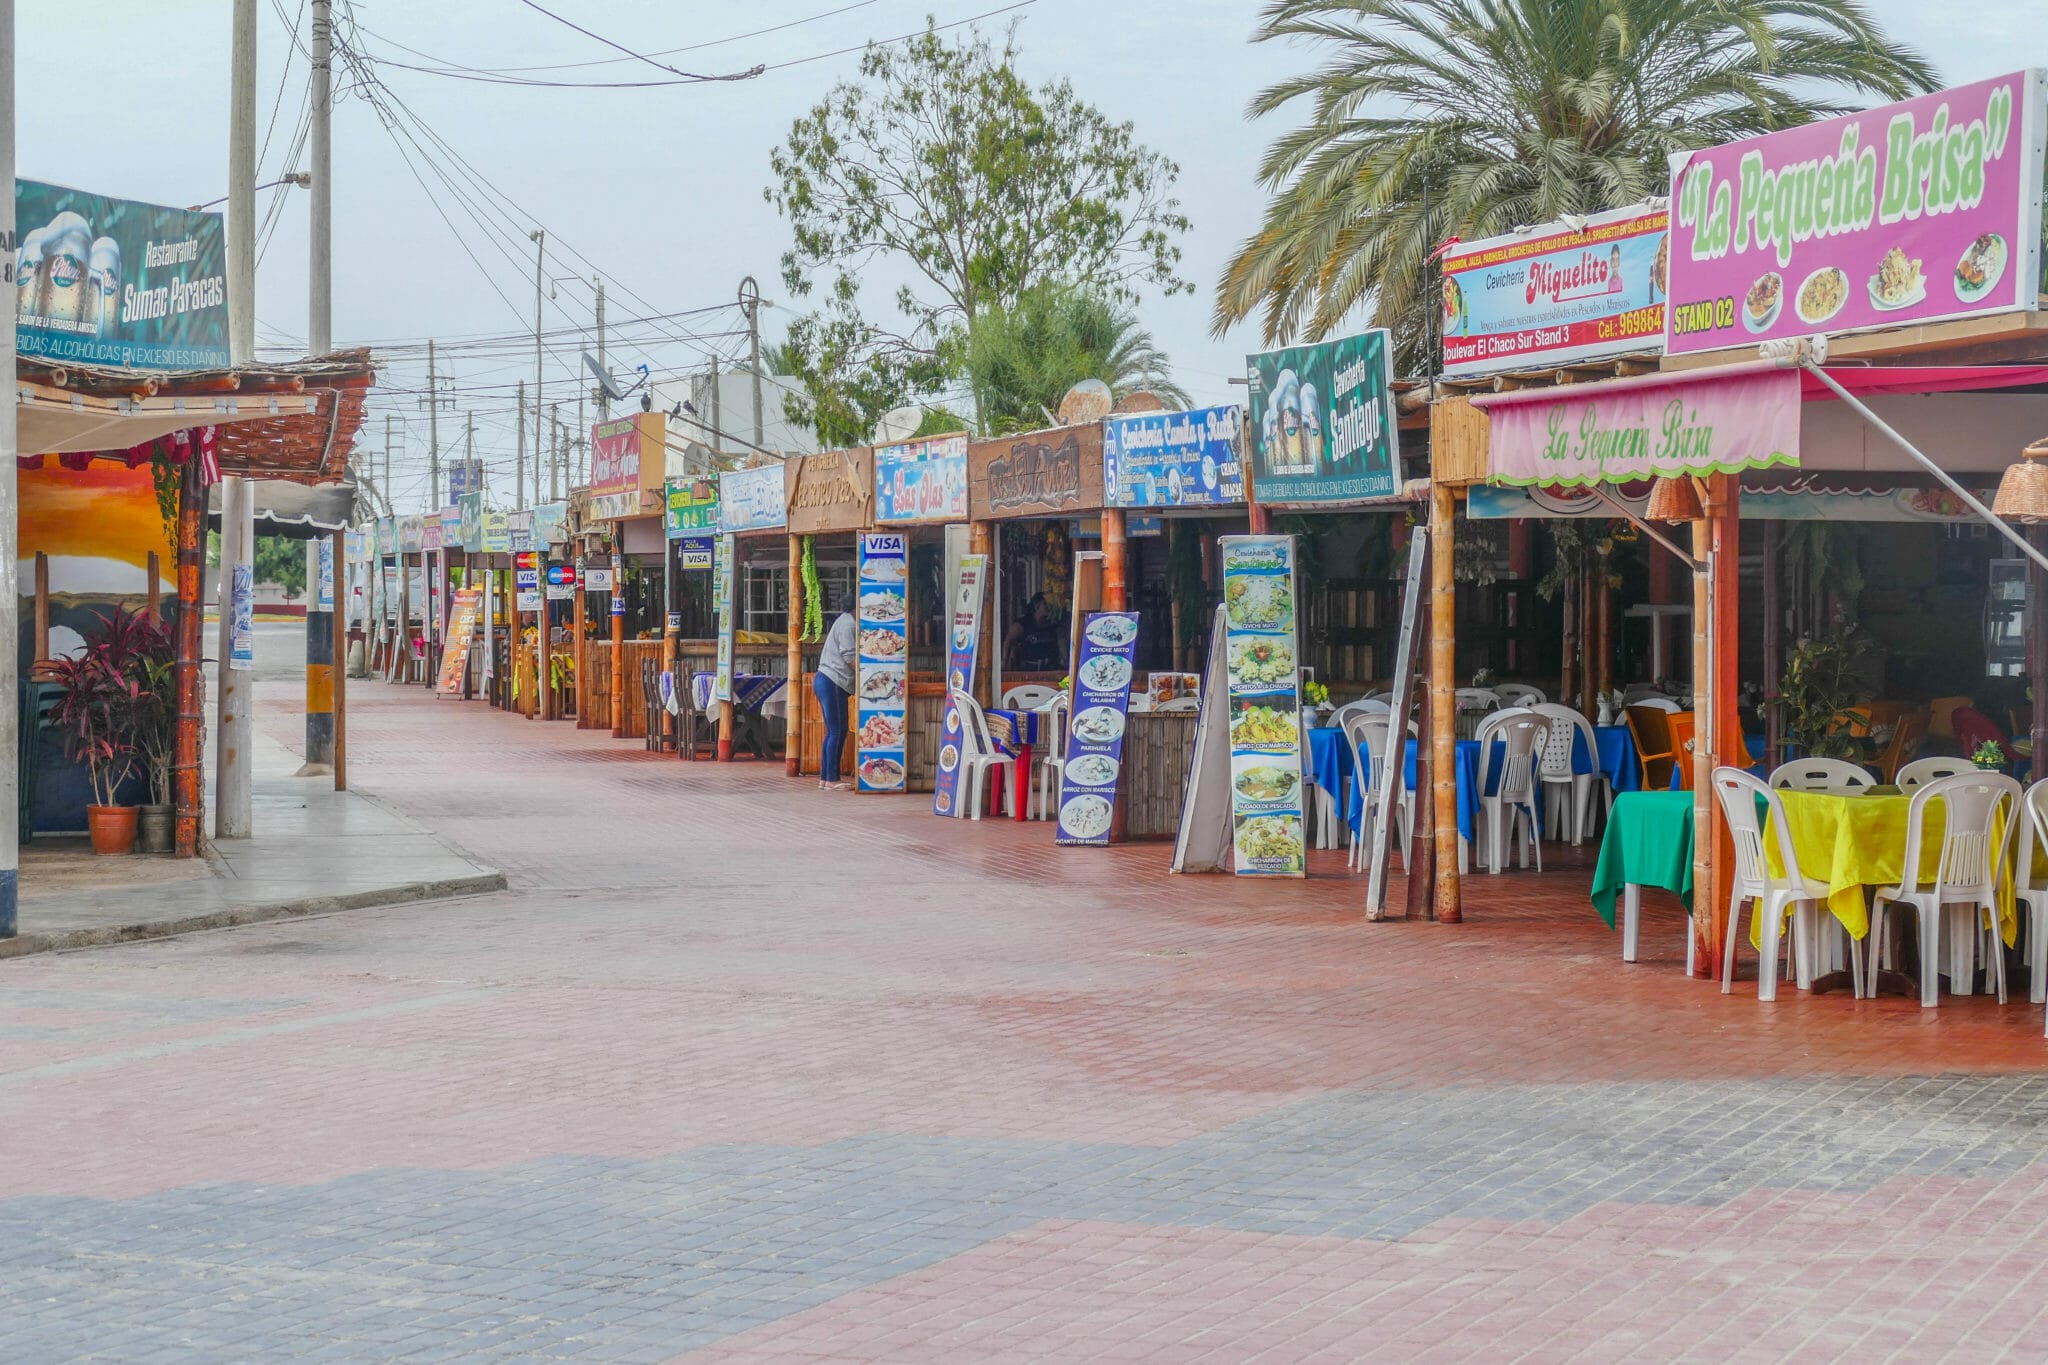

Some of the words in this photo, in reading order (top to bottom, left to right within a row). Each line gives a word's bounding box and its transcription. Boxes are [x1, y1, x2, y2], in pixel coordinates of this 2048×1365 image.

[1734, 121, 1876, 268] Pequeña
[145, 234, 198, 268] Restaurante
[1509, 244, 1534, 258] BROCHETAS
[1535, 243, 1541, 252] DE
[1542, 240, 1556, 250] POLLO
[1557, 238, 1560, 247] O
[1562, 237, 1568, 246] DE
[1620, 224, 1627, 234] EN
[1628, 221, 1644, 233] SALSA
[1644, 219, 1652, 229] DE
[5, 263, 12, 282] 8
[50, 255, 80, 281] Pilsen
[1486, 267, 1524, 290] Cevichería
[1526, 251, 1608, 304] Miguelito
[122, 283, 168, 323] Sumac
[170, 276, 224, 315] Paracas
[19, 316, 35, 326] SABOR
[36, 318, 42, 327] DE
[43, 319, 49, 328] LA
[50, 319, 78, 332] VERDADERA
[1674, 302, 1714, 336] STAND
[1715, 296, 1734, 329] 02
[50, 338, 120, 362] ALCOHÓLICAS
[122, 348, 135, 362] EN
[138, 349, 176, 364] EXCESO
[177, 351, 190, 364] ES
[1478, 339, 1486, 356] El
[1488, 337, 1515, 354] Chaco
[1517, 332, 1533, 349] Sur
[1535, 327, 1561, 346] Stand
[1564, 326, 1570, 342] 3
[1334, 356, 1366, 398] Cevichería
[1164, 415, 1197, 446] Camila
[1198, 424, 1205, 452] y
[1330, 397, 1379, 462] Santiago
[1542, 402, 1568, 460] La
[1656, 399, 1713, 458] Brisa
[1106, 440, 1116, 455] PTO
[893, 467, 916, 514] Las
[919, 471, 944, 514] Olas
[1108, 459, 1116, 495] 5
[1220, 483, 1242, 498] PARACAS
[1255, 484, 1272, 497] TOMAR
[1272, 483, 1294, 497] BEBIDAS
[1295, 480, 1329, 496] ALCOHÓLICAS
[1330, 481, 1338, 496] EN
[1338, 479, 1360, 494] EXCESO
[1361, 479, 1369, 493] ES
[688, 555, 707, 563] VISA
[868, 537, 901, 550] VISA
[1226, 557, 1282, 571] Santiago
[613, 600, 624, 608] IS
